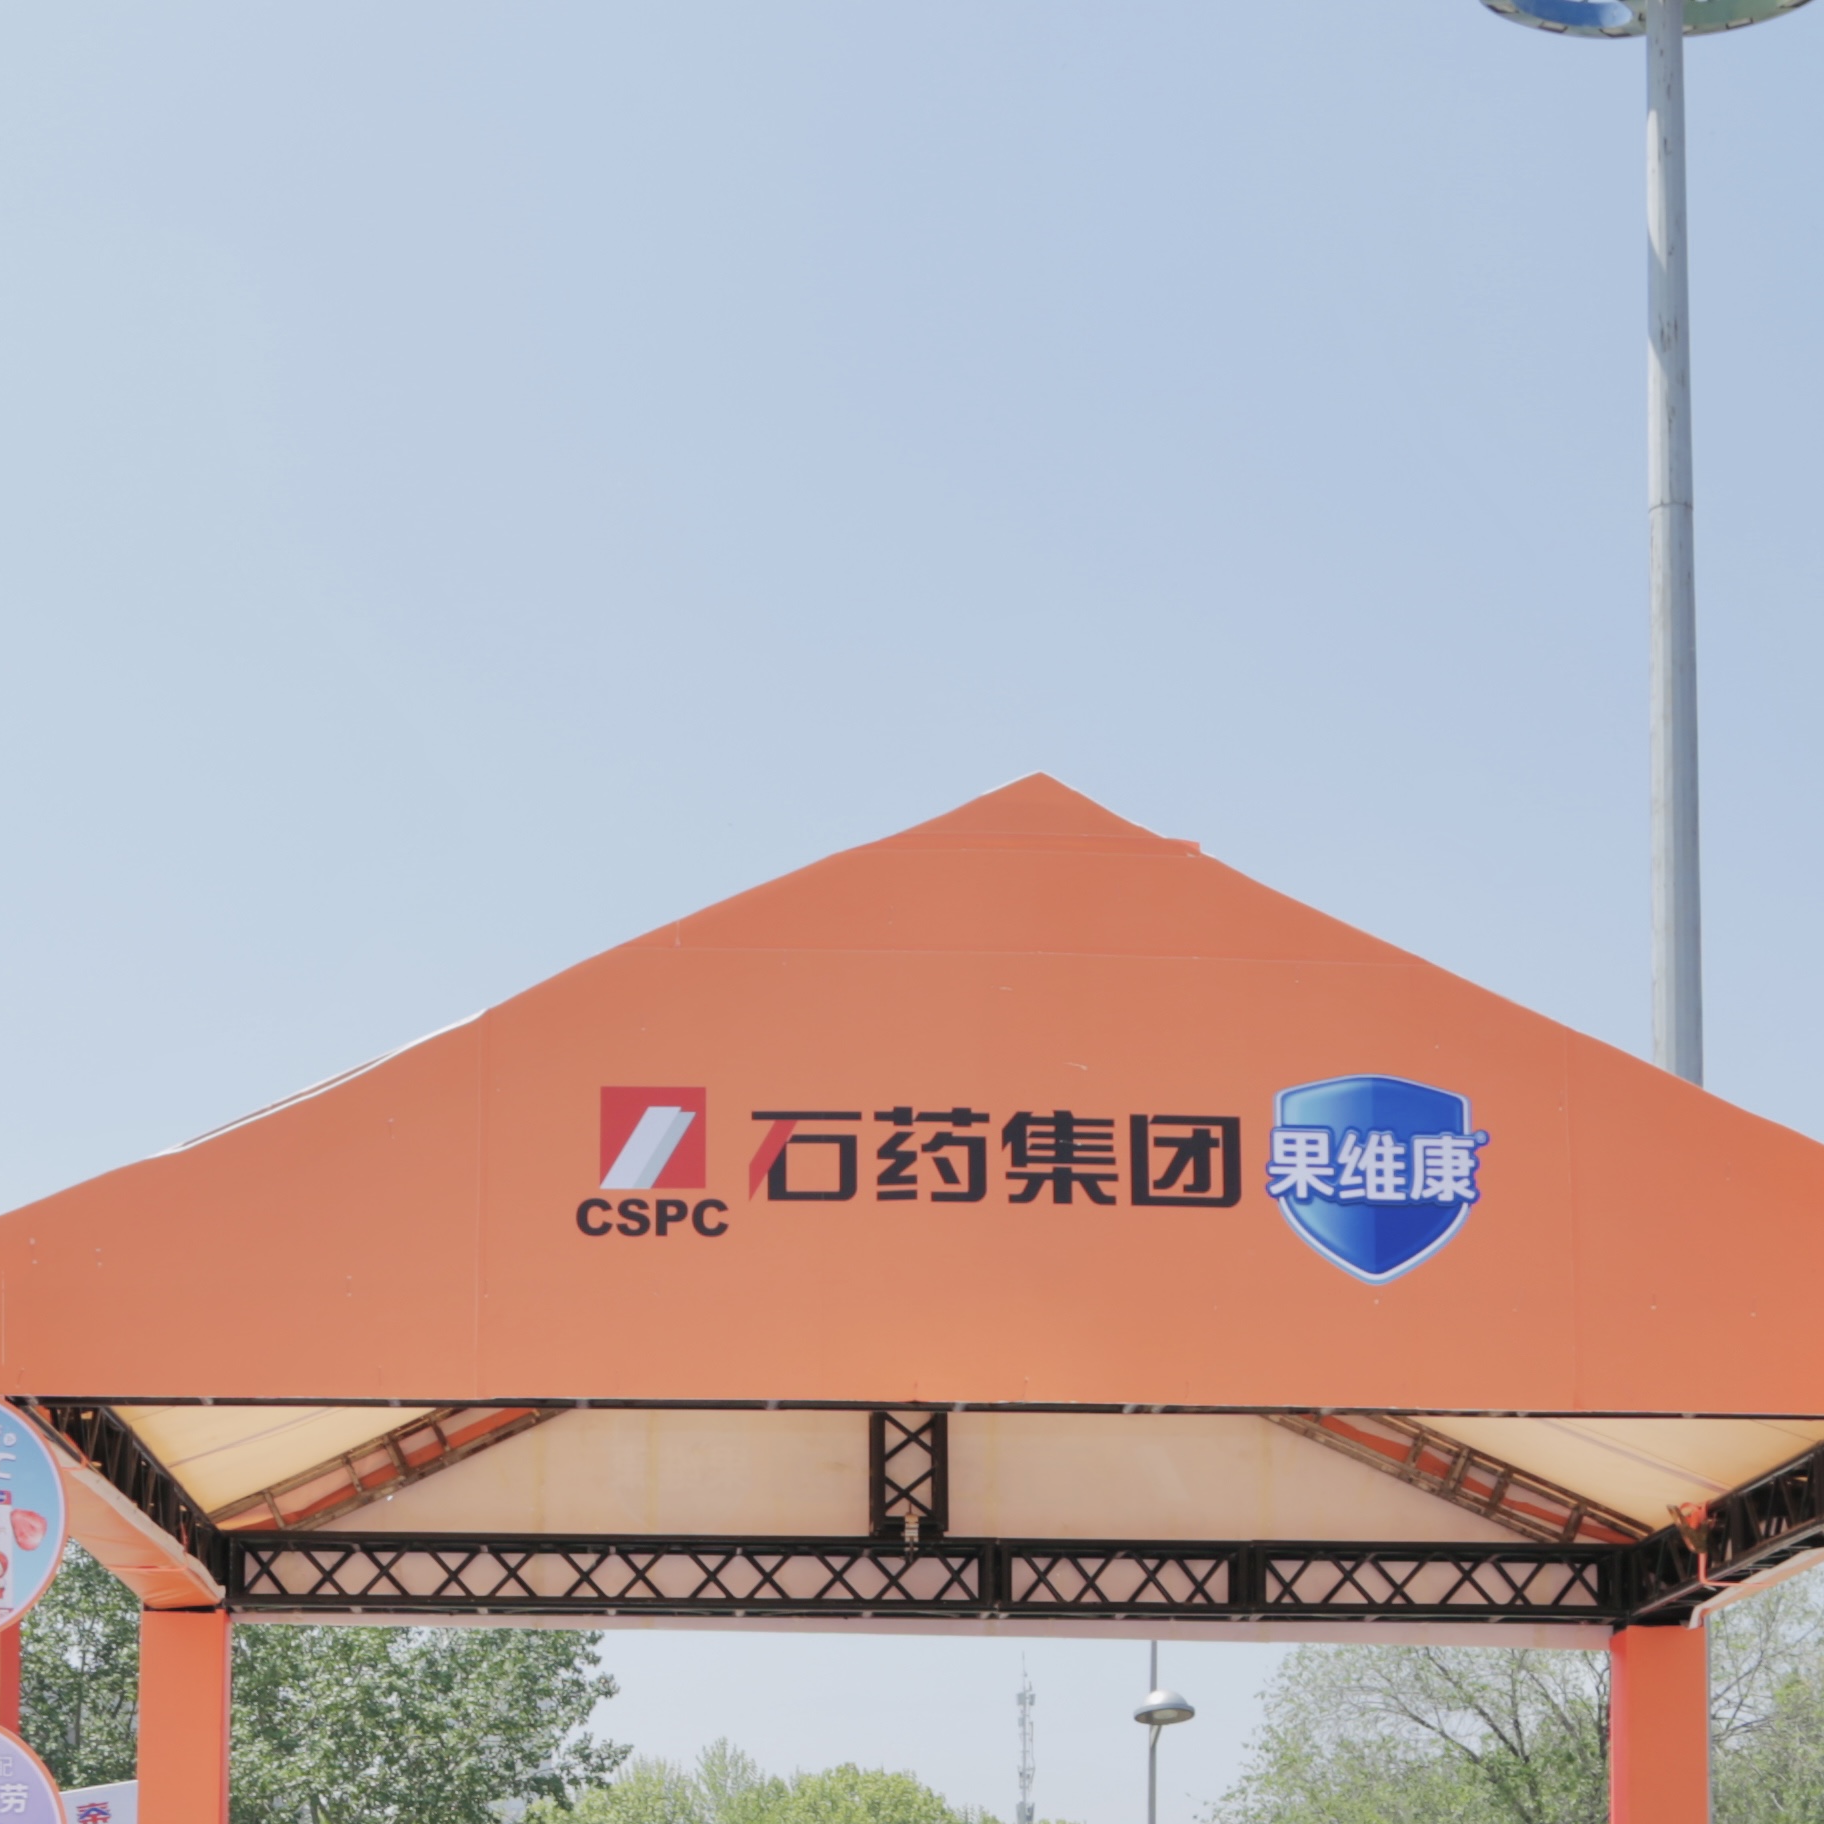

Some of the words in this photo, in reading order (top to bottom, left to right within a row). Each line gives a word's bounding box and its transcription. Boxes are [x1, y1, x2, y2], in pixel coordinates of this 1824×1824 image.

[749, 1107, 1241, 1208] 石药集团
[1266, 1127, 1477, 1203] 果维康
[576, 1198, 729, 1236] CSPC
